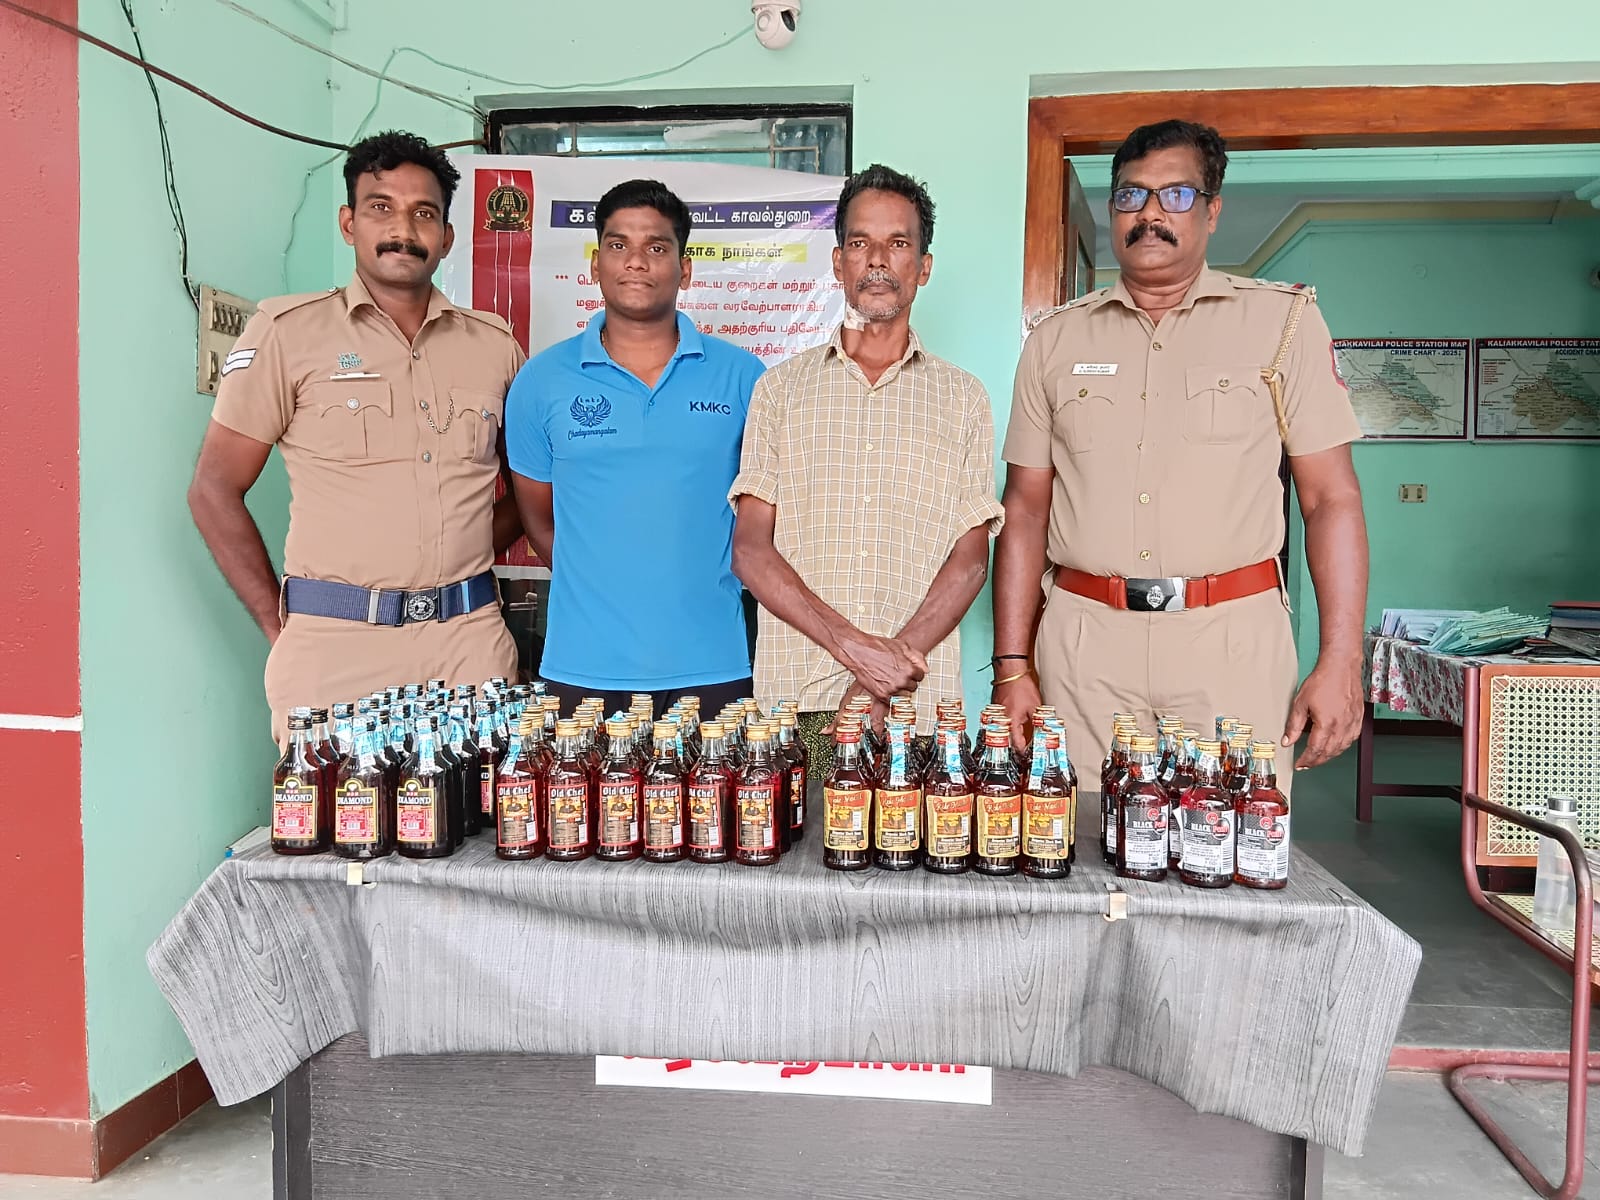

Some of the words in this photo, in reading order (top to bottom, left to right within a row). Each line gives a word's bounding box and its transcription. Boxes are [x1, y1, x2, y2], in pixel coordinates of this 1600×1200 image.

[689, 206, 725, 223] வட்ட
[731, 205, 811, 228] காவல்துறை
[722, 242, 783, 261] நாங்கள்
[1334, 340, 1383, 348] LIAKKAVILAI
[689, 401, 731, 415] KMKC
[499, 787, 511, 796] Old
[512, 784, 531, 794] Chef
[551, 788, 564, 797] Old
[566, 787, 585, 796] Chef
[602, 786, 617, 795] Old
[619, 784, 636, 794] Chef
[645, 789, 657, 798] Old
[659, 788, 678, 797] Chef
[696, 788, 714, 797] Chef
[737, 790, 749, 799] Old
[751, 789, 770, 799] Chef
[275, 793, 312, 802] DIAMOND
[1132, 820, 1153, 828] BLACK
[1190, 823, 1211, 832] BLACK
[1244, 827, 1265, 837] BLACK
